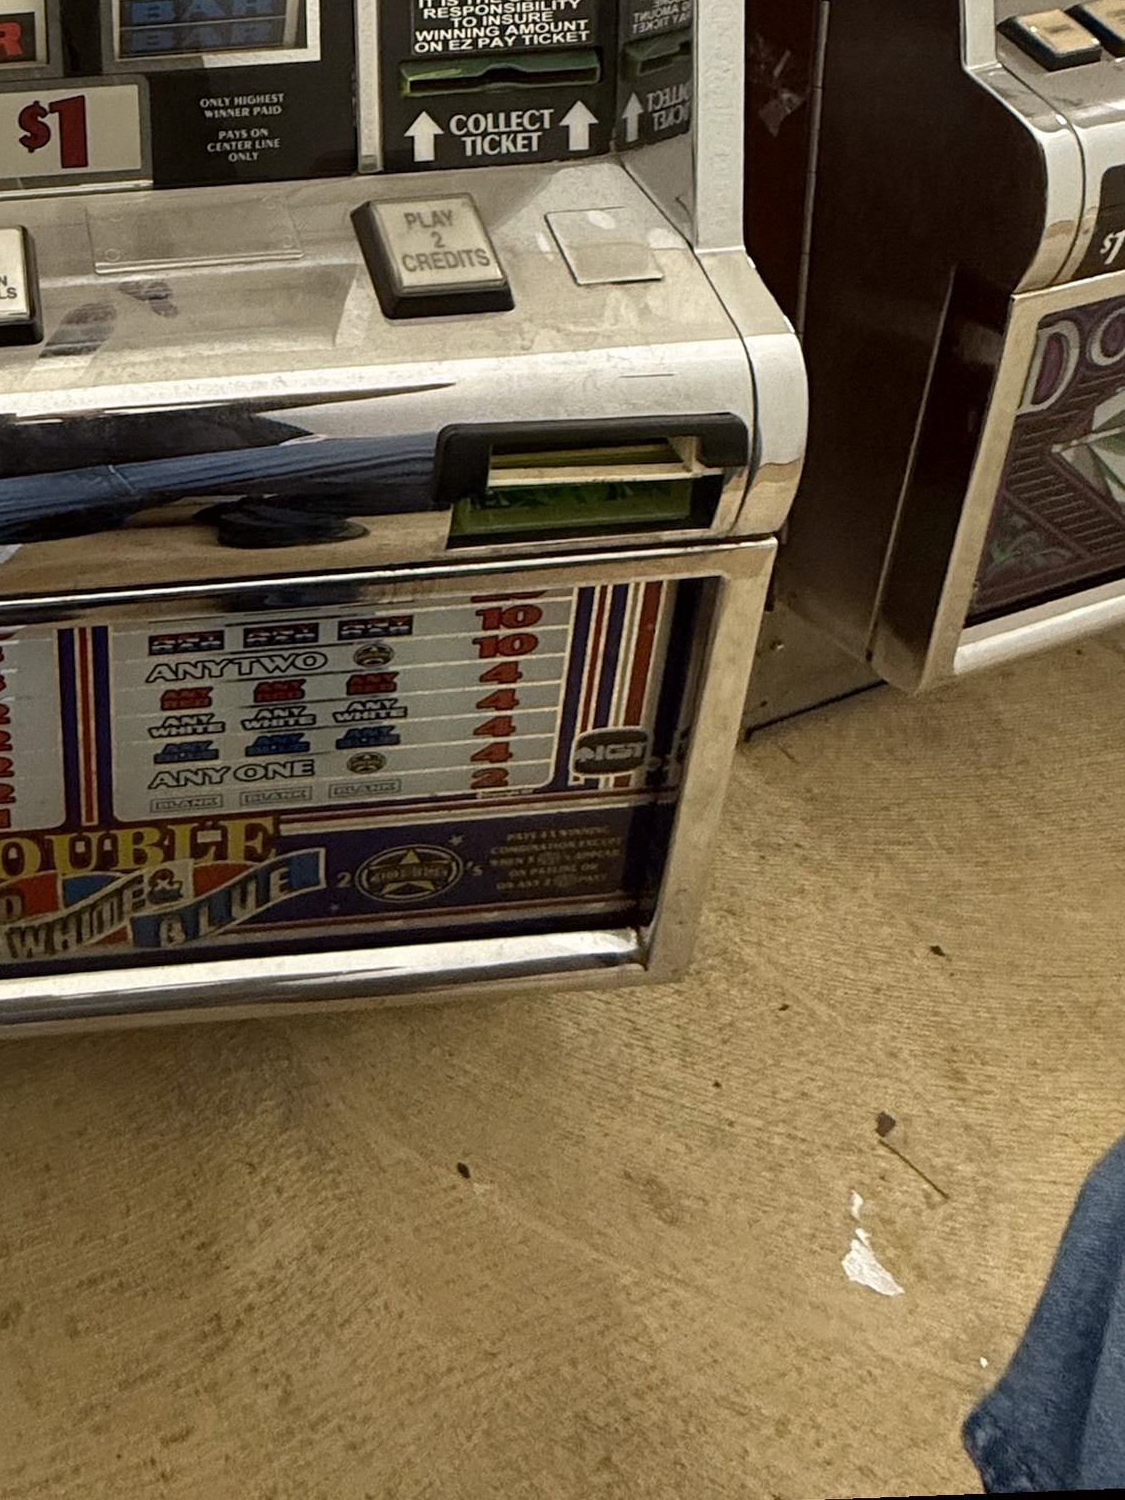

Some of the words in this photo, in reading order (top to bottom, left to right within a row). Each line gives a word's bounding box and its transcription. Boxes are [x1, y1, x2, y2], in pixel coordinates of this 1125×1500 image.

[415, 26, 500, 41] WINNING
[505, 20, 588, 35] AMOUNT
[451, 17, 476, 28] TO
[482, 11, 553, 26] INSURE
[414, 42, 443, 53] ON
[449, 39, 473, 50] EZ
[478, 36, 516, 48] PAY
[522, 30, 590, 45] TICKET
[200, 97, 231, 109] ONLY
[234, 94, 284, 106] HIGHEST
[204, 106, 249, 119] WINNER
[253, 104, 282, 116] PAID
[18, 95, 88, 169] $1
[218, 128, 247, 140] PAYS
[250, 127, 268, 138] ON
[449, 109, 554, 136] COLLECT
[207, 139, 252, 152] CENTER
[255, 138, 281, 149] LINE
[461, 132, 543, 157] TICKET
[228, 152, 259, 162] ONLY
[404, 209, 453, 229] PLAY
[431, 231, 445, 248] 2
[402, 249, 490, 273] CREDITS
[475, 604, 543, 631] 10
[472, 633, 538, 659] 10
[479, 661, 523, 684] 4
[148, 767, 231, 789] ANY
[234, 759, 315, 781] ONE
